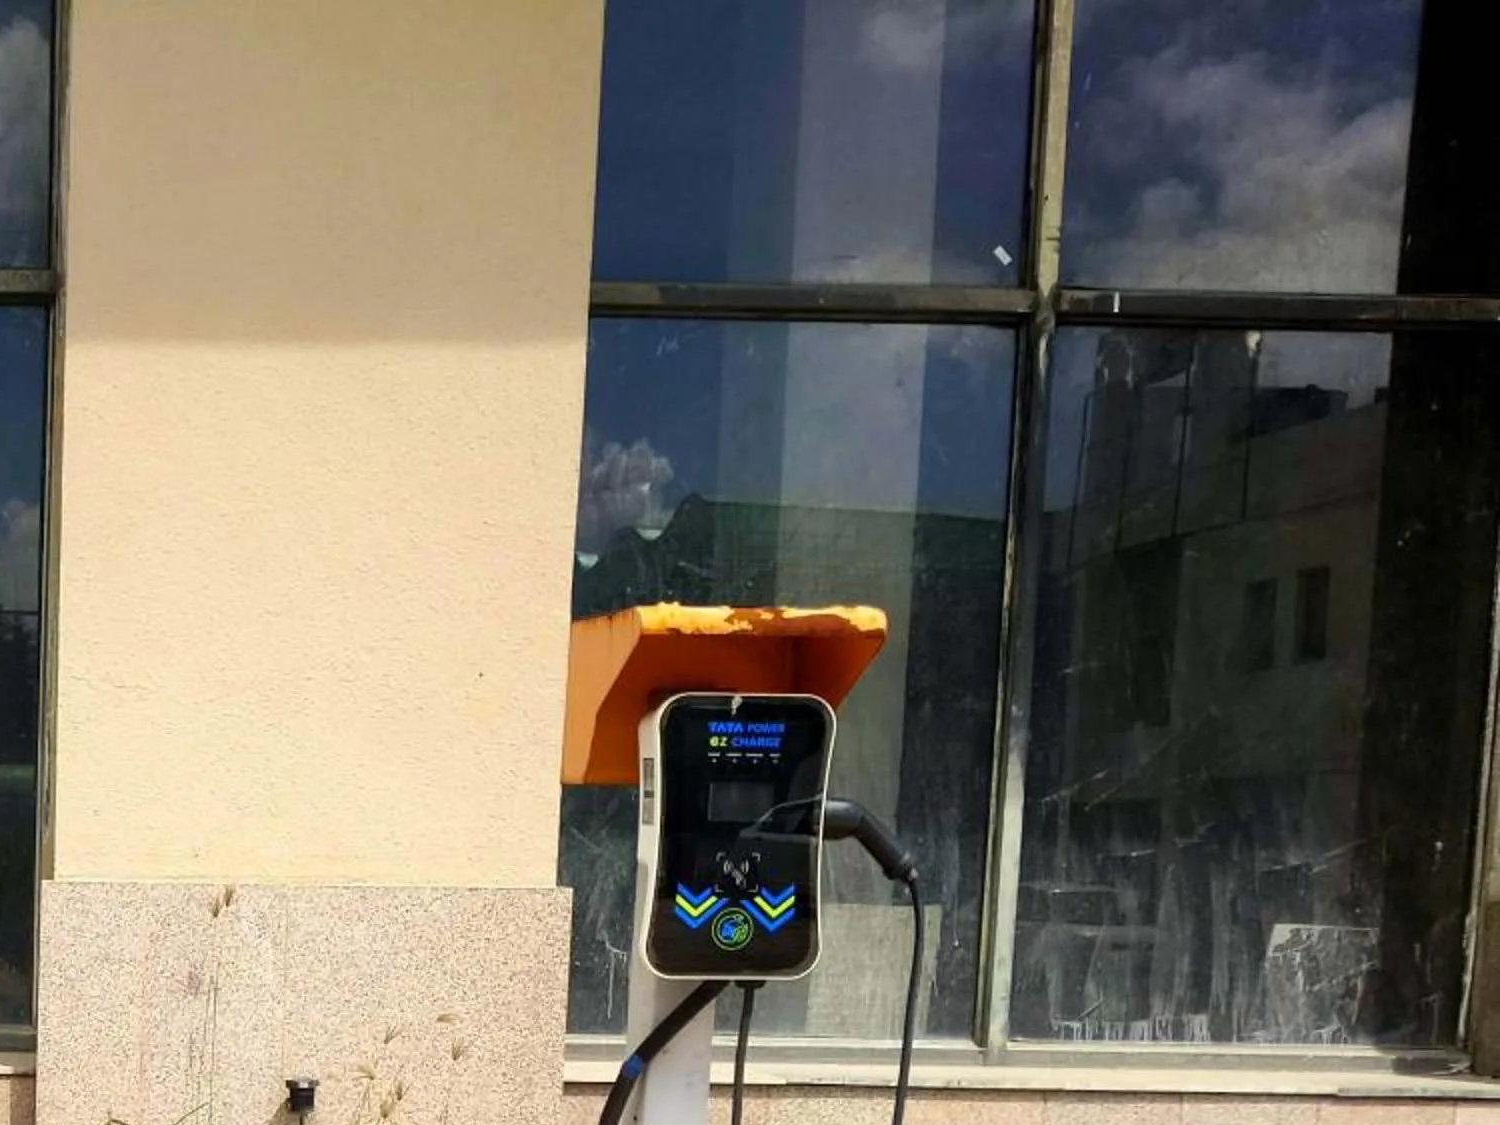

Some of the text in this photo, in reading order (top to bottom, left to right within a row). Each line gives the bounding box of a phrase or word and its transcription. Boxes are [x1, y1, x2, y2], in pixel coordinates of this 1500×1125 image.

[708, 722, 785, 733] TATA POWER
[731, 737, 781, 748] CHARGE
